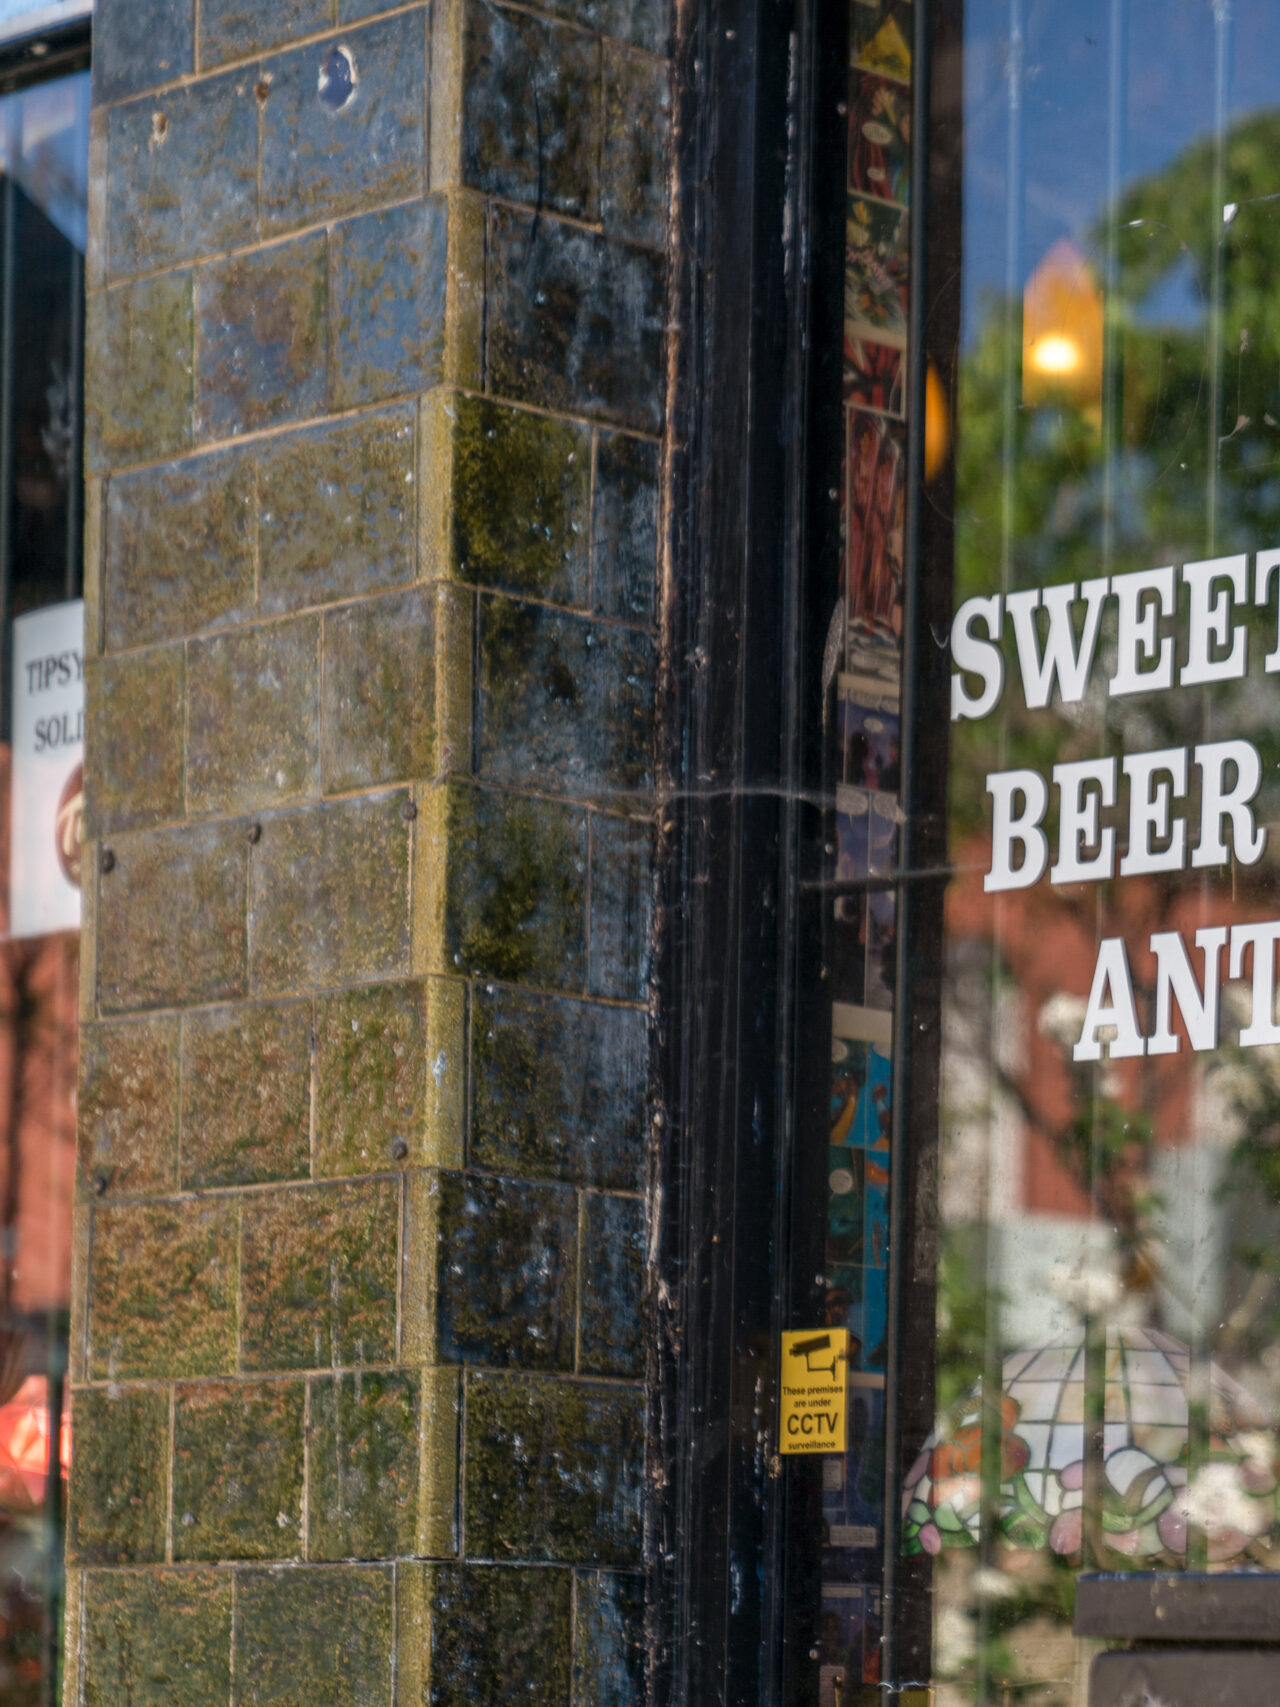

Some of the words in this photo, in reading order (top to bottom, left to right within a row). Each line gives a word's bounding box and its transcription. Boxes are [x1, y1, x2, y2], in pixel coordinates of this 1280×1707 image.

[25, 649, 84, 695] TIPSY
[34, 709, 84, 753] SOL
[984, 740, 1265, 892] BEER
[783, 1386, 805, 1396] These
[808, 1384, 843, 1396] premises
[808, 1397, 831, 1408] under
[787, 1412, 838, 1435] CCTV
[788, 1440, 836, 1450] surveillance
